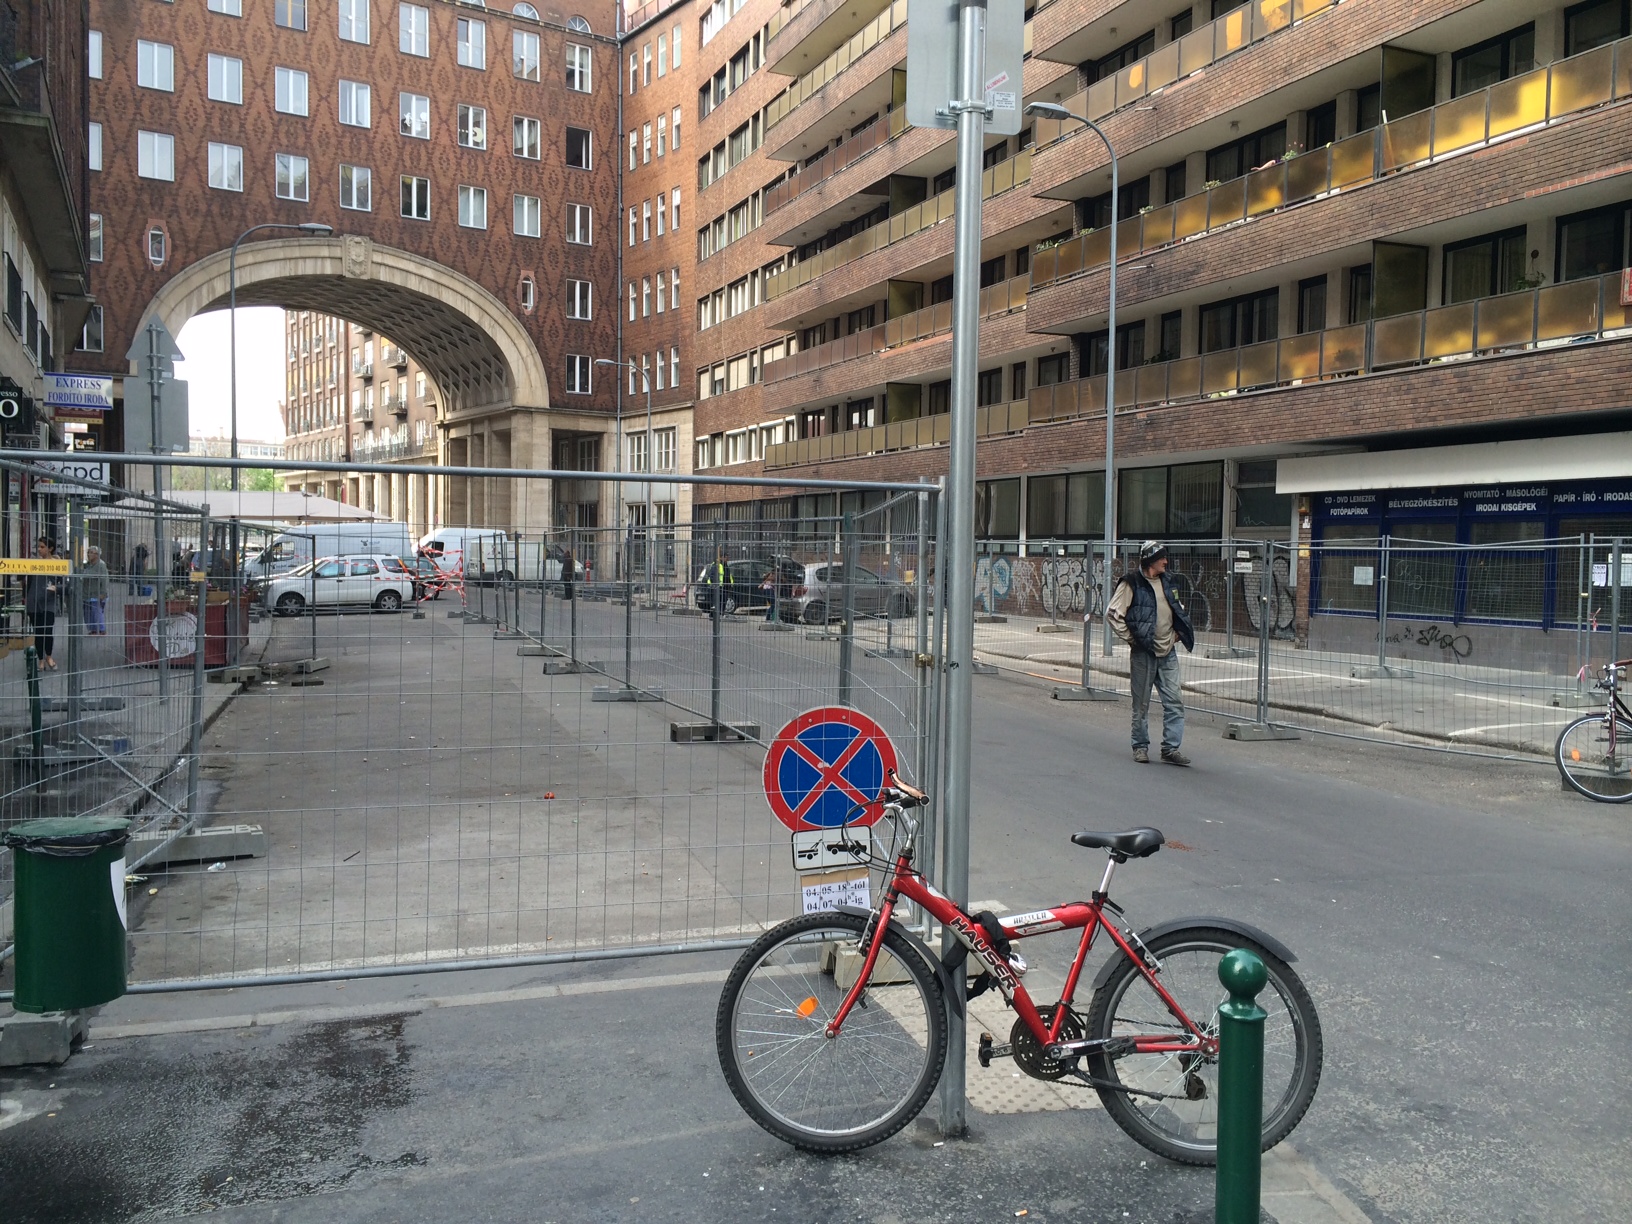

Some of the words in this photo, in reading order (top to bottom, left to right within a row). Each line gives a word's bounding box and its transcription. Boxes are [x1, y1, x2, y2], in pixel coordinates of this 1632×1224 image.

[56, 378, 102, 389] EXPRESS
[48, 390, 83, 402] FORDÍTÓ
[84, 393, 109, 405] IRODA
[1464, 487, 1500, 499] NYOMTATÓ
[1554, 491, 1576, 502] PAPÍR
[1583, 491, 1597, 502] ÍRÓ
[1324, 496, 1333, 504] CD
[1350, 495, 1376, 503] LEMEZEK
[1330, 506, 1368, 516] FOTÓPAPÍROK
[1476, 503, 1499, 512] IRODAI
[1501, 501, 1537, 511] KISGÉPEK
[806, 888, 820, 898] 04.
[822, 886, 835, 895] 05.
[807, 902, 820, 911] 04.
[950, 915, 1019, 991] HAUSER
